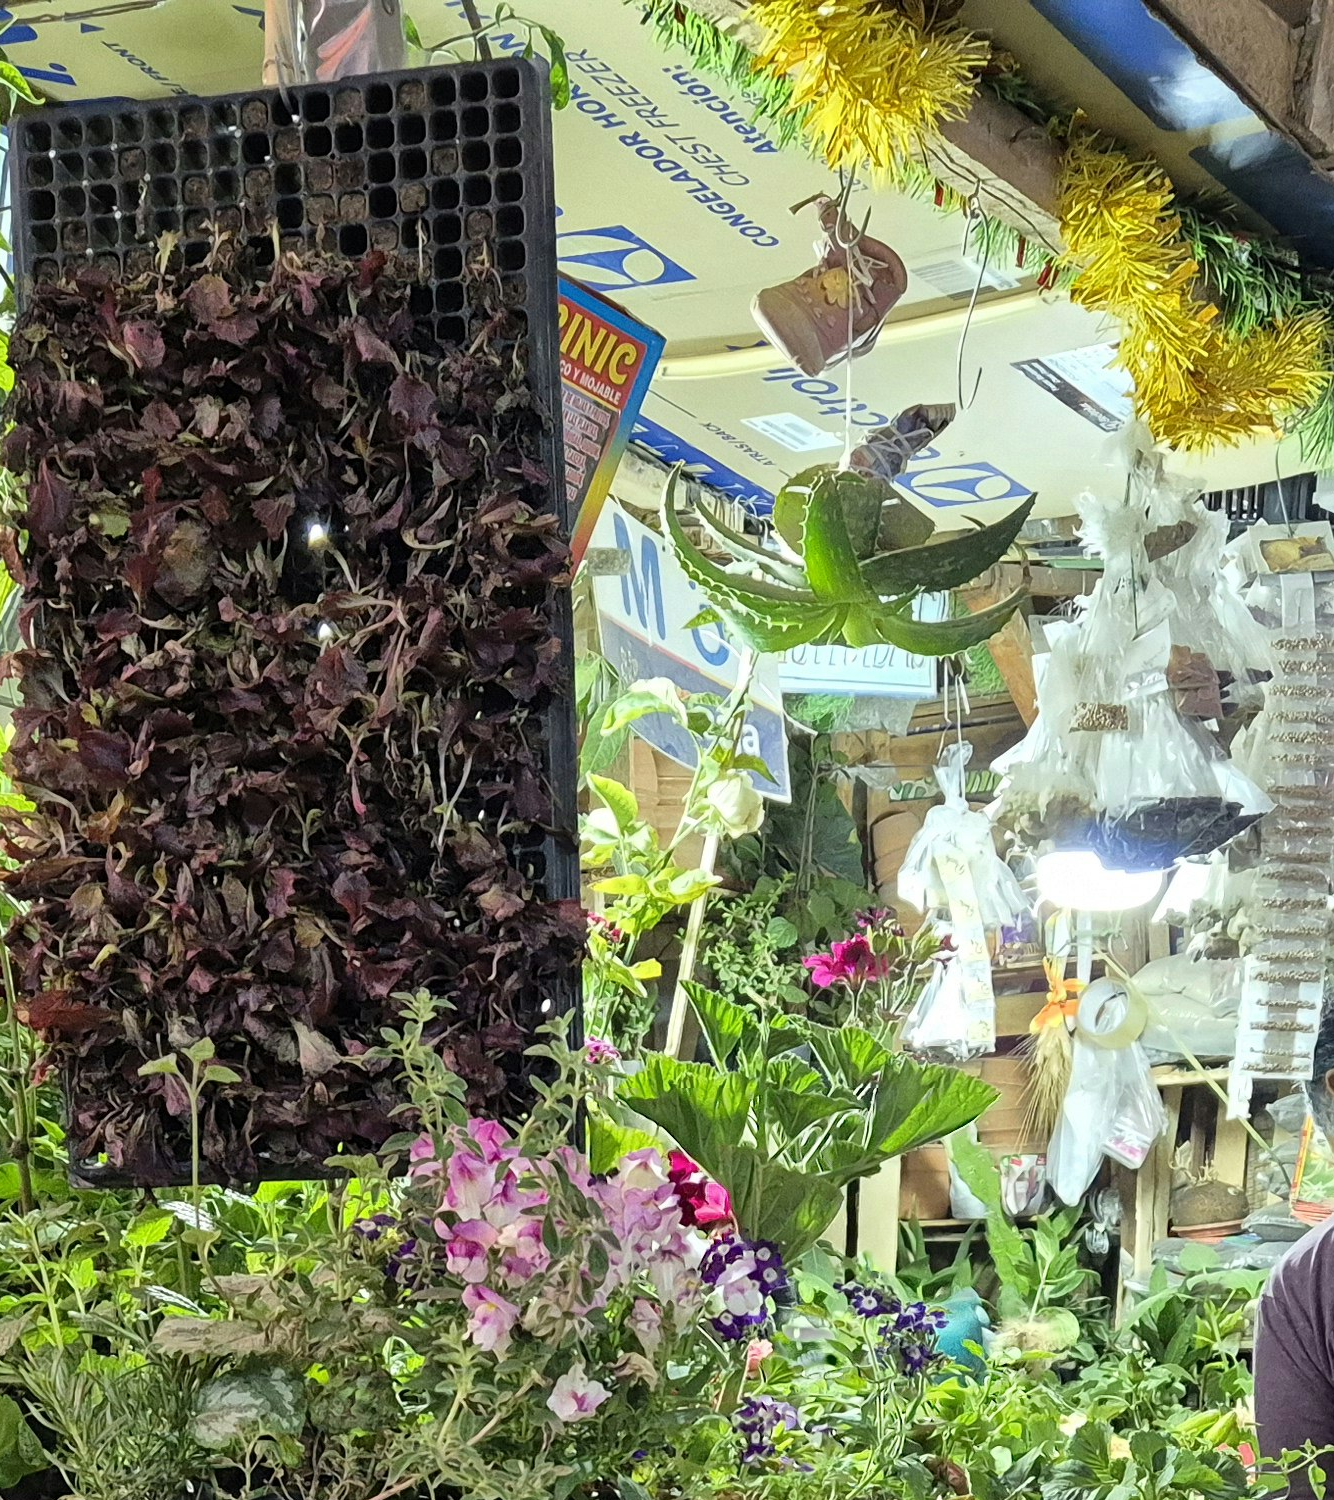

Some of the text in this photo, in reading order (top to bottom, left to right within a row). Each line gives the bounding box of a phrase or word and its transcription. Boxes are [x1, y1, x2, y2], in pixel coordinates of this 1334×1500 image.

[565, 48, 681, 129] FREEZER
[662, 64, 778, 153] Atención:
[618, 131, 780, 247] CONGELADOR
[663, 134, 750, 186] CHEST
[579, 371, 622, 405] MOJABLE
